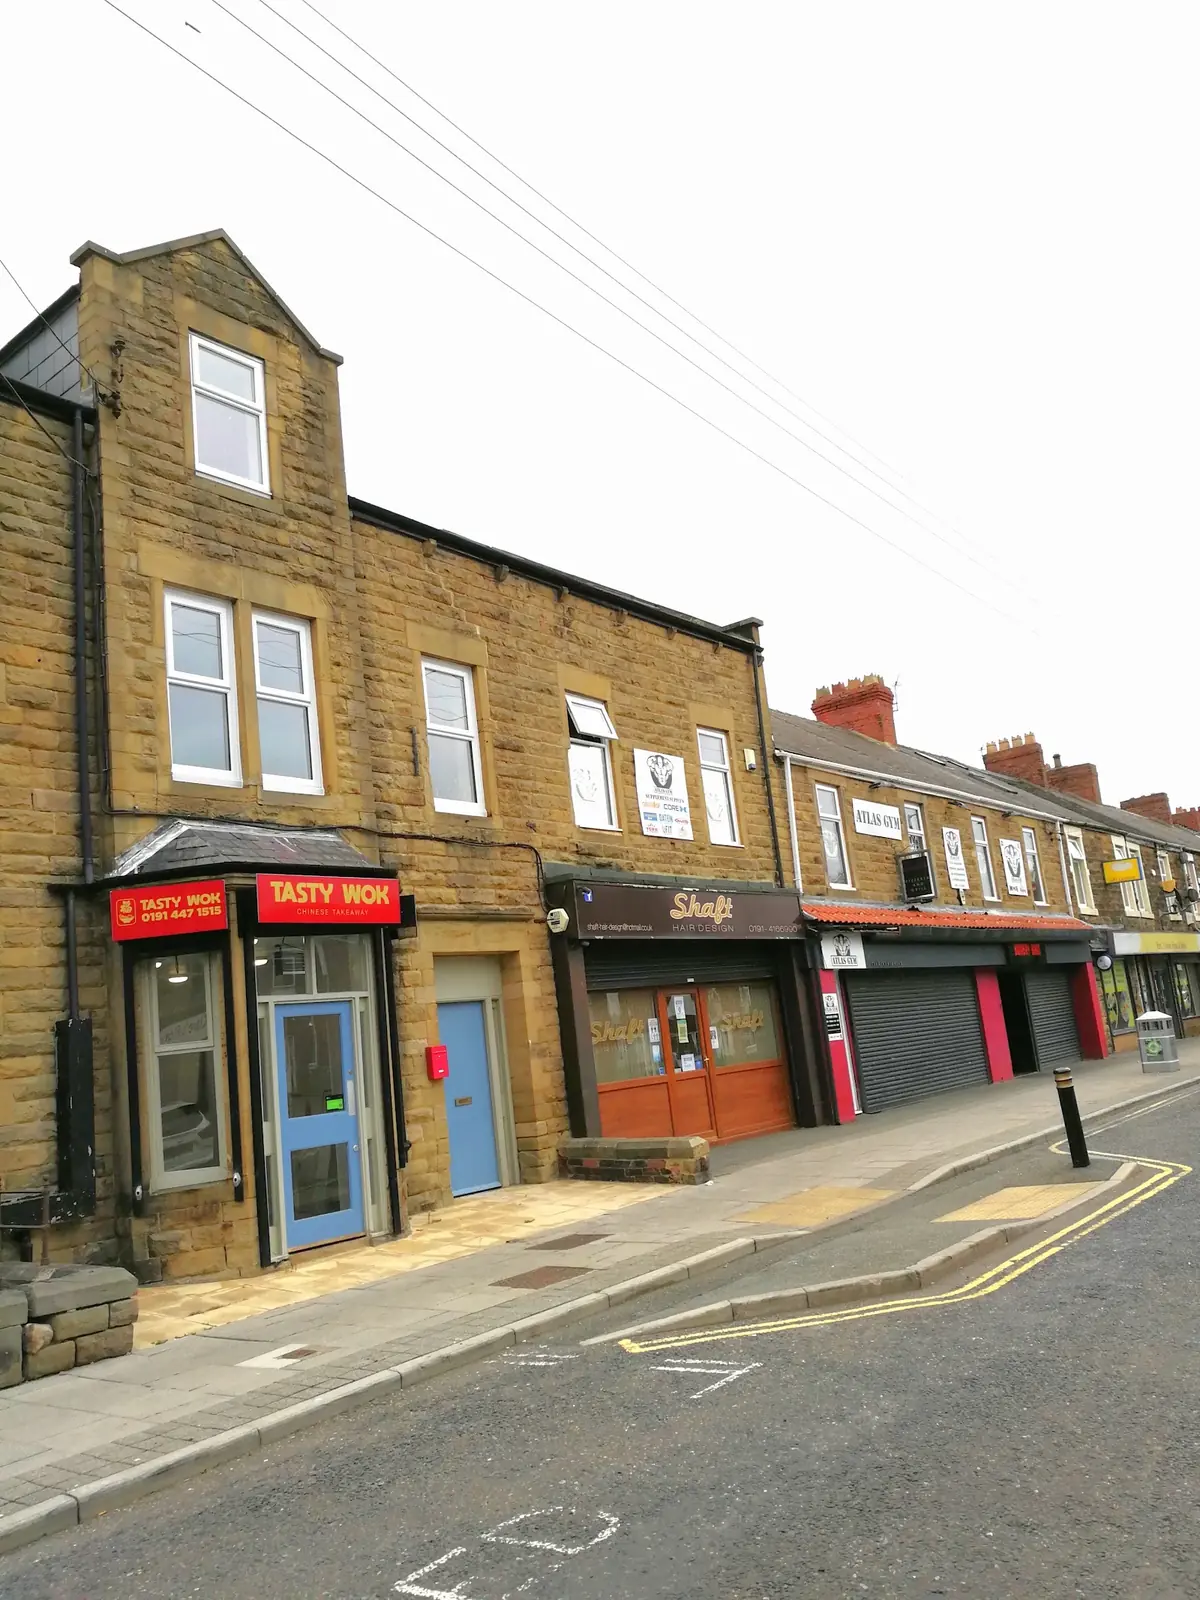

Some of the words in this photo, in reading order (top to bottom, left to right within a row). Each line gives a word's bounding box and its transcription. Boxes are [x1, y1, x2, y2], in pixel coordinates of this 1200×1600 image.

[856, 810, 881, 827] ATLAS
[883, 815, 900, 830] GYM
[140, 896, 182, 911] TASTY
[187, 892, 221, 906] WOK
[270, 881, 334, 903] TASTY
[342, 883, 390, 905] WOK
[141, 911, 168, 923] 0191
[170, 909, 195, 920] 447
[197, 906, 222, 918] 1515
[296, 908, 329, 916] CHINESE
[332, 908, 369, 916] TAKEAWAY
[670, 893, 733, 925] Shaft
[672, 924, 696, 932] HAIR
[697, 924, 734, 932] DESIGN
[832, 957, 846, 965] ATLAS
[847, 957, 858, 965] GYM
[591, 1018, 644, 1044] Shaft
